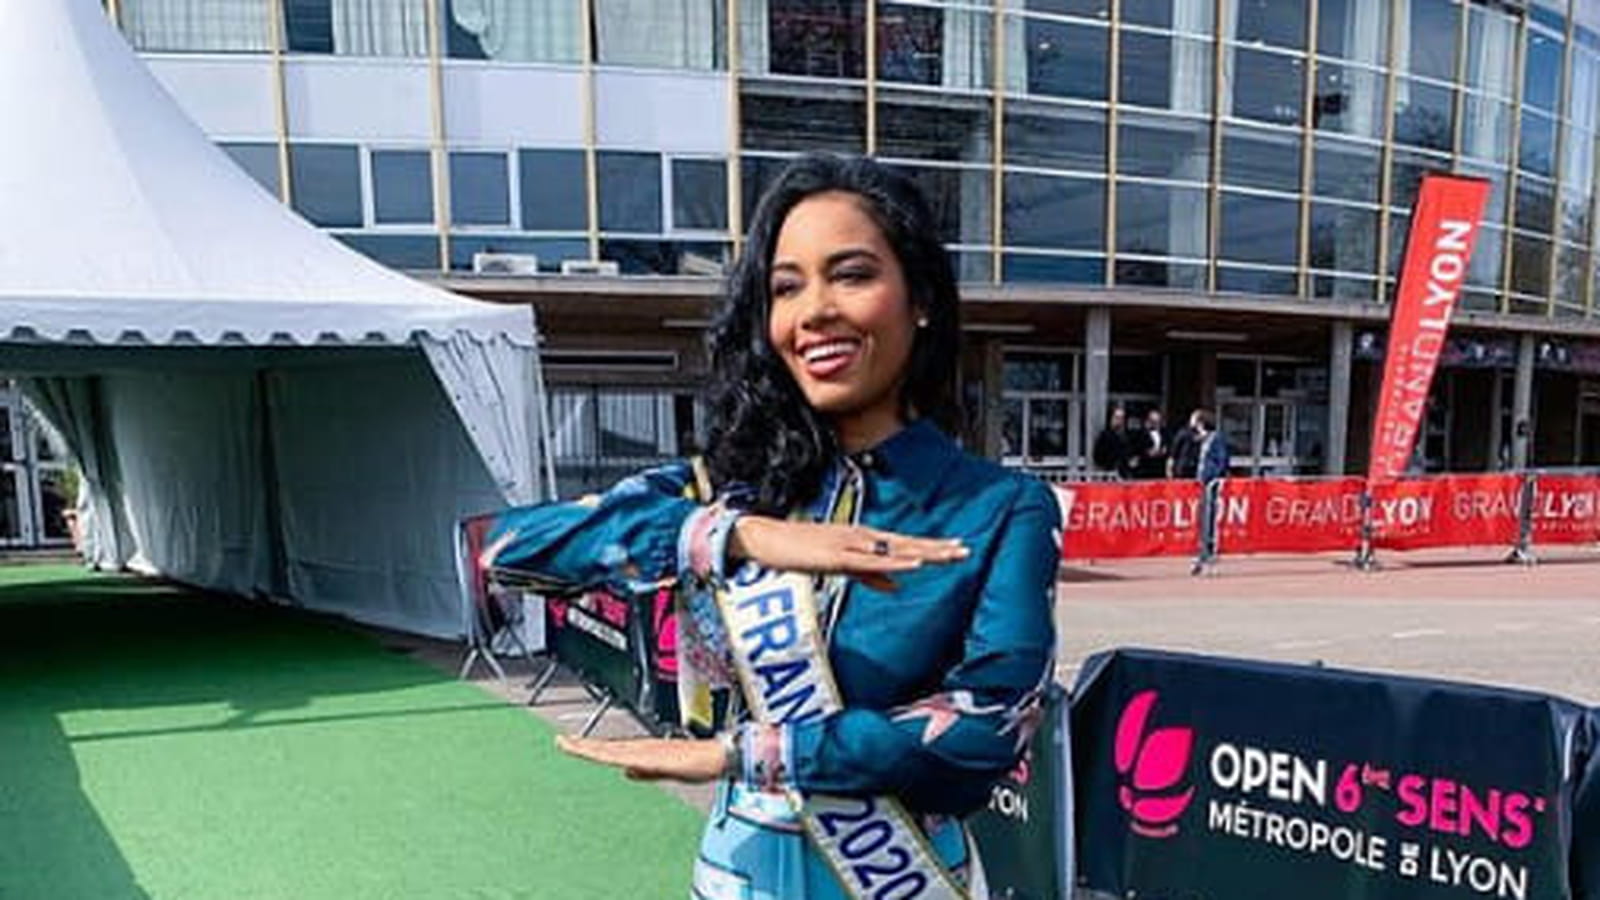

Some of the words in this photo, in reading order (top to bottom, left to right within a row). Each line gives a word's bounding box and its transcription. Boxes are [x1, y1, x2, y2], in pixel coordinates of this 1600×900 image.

[1066, 496, 1249, 532] GRANDLYN
[1210, 743, 1327, 807] OPEN
[814, 798, 928, 900] 2020
[1208, 799, 1388, 871] MÉTROPOLE
[1429, 845, 1528, 900] LYON
